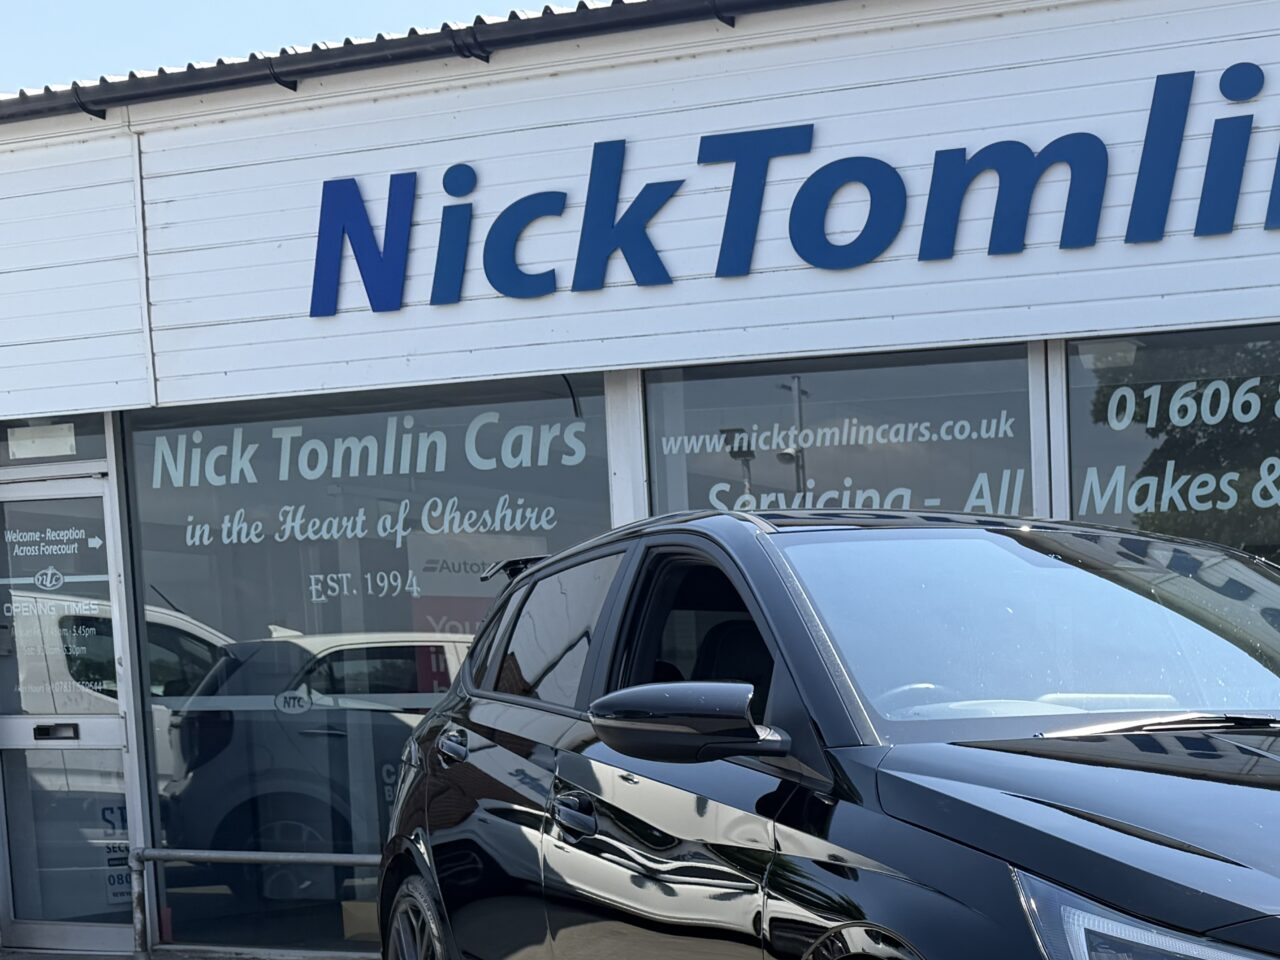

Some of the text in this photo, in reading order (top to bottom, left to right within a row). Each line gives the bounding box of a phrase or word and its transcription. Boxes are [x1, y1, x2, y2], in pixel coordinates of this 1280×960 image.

[1107, 376, 1261, 431] 01606
[152, 412, 587, 488] Nick Tomlin Cars
[661, 410, 1015, 455] www.nicktomlincars.co.uk
[963, 468, 1025, 516] All
[1078, 460, 1240, 516] Makes
[4, 529, 40, 542] Welcome
[46, 527, 85, 543] Reception
[185, 494, 557, 548] in the Heart of Cheshire
[13, 542, 78, 556] Across Forecourt
[309, 569, 420, 603] EST. 1994
[283, 696, 305, 709] NTC
